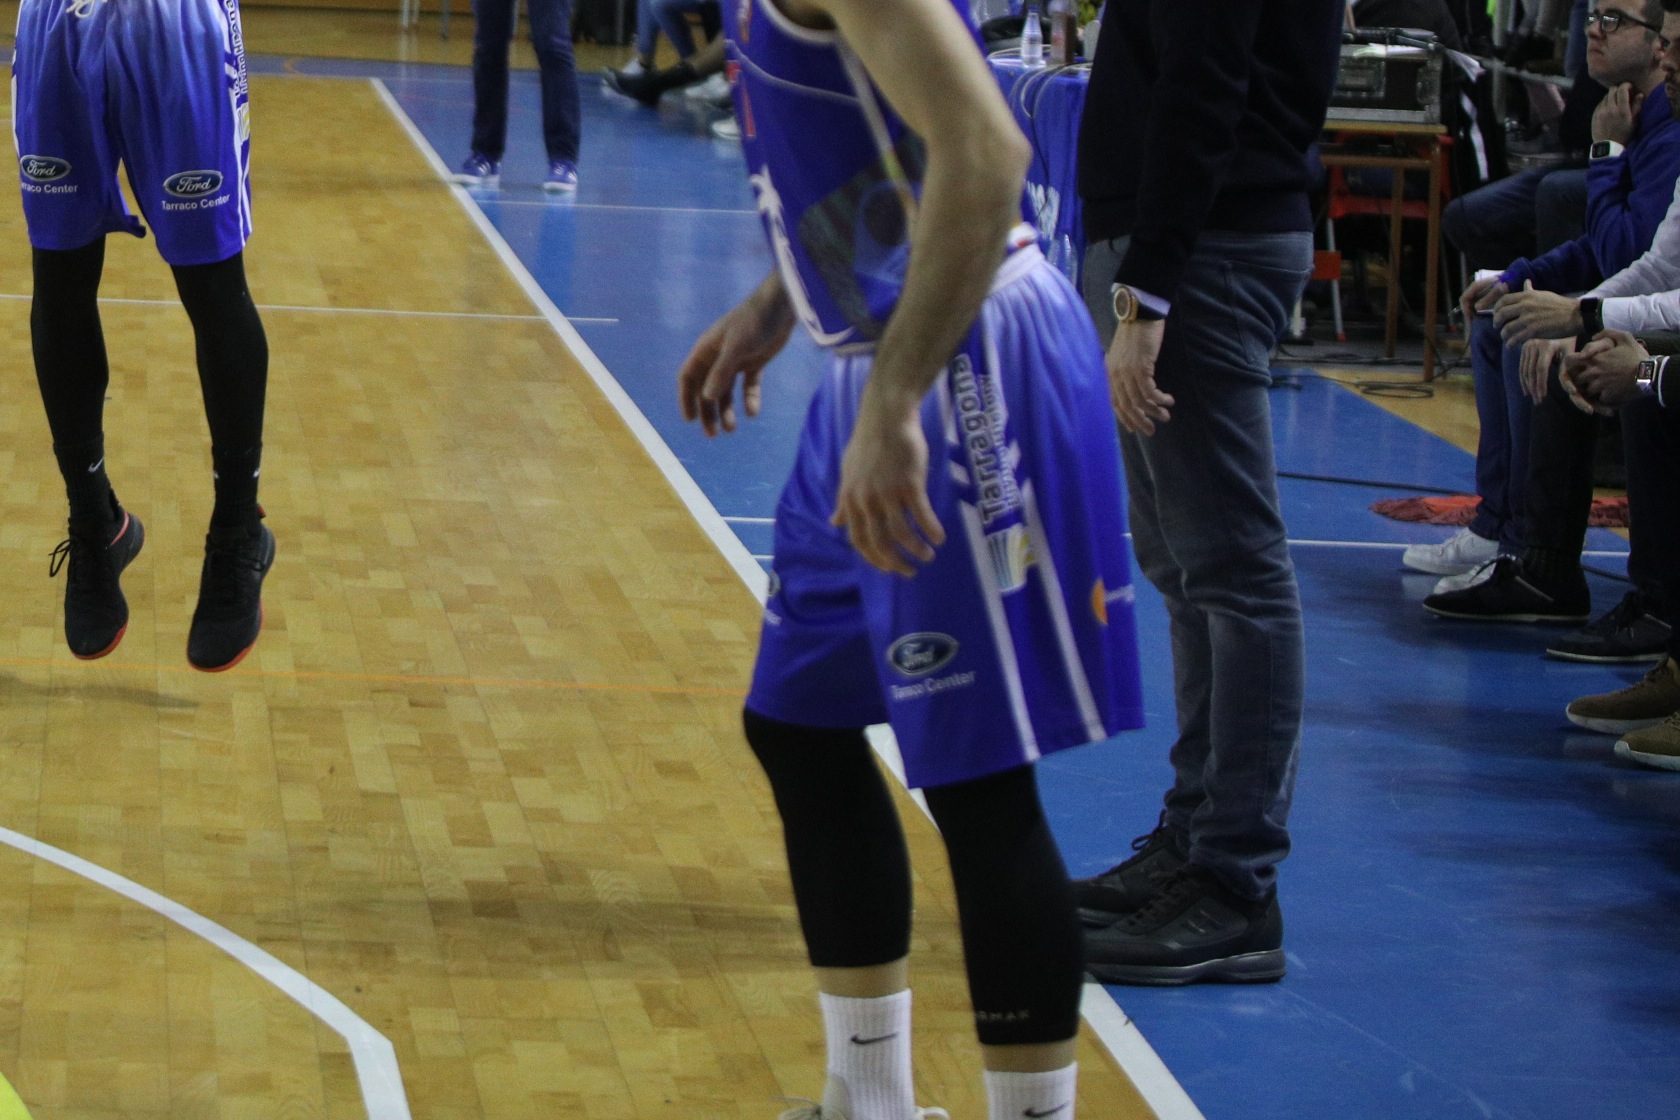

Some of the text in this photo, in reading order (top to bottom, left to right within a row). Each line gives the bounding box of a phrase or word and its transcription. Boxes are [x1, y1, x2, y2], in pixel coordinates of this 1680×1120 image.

[26, 159, 57, 177] Ford
[43, 183, 79, 193] Center
[176, 176, 212, 192] Ford
[162, 193, 231, 210] Tarraco Center
[953, 355, 1006, 522] Tarragona
[924, 671, 976, 692] Center
